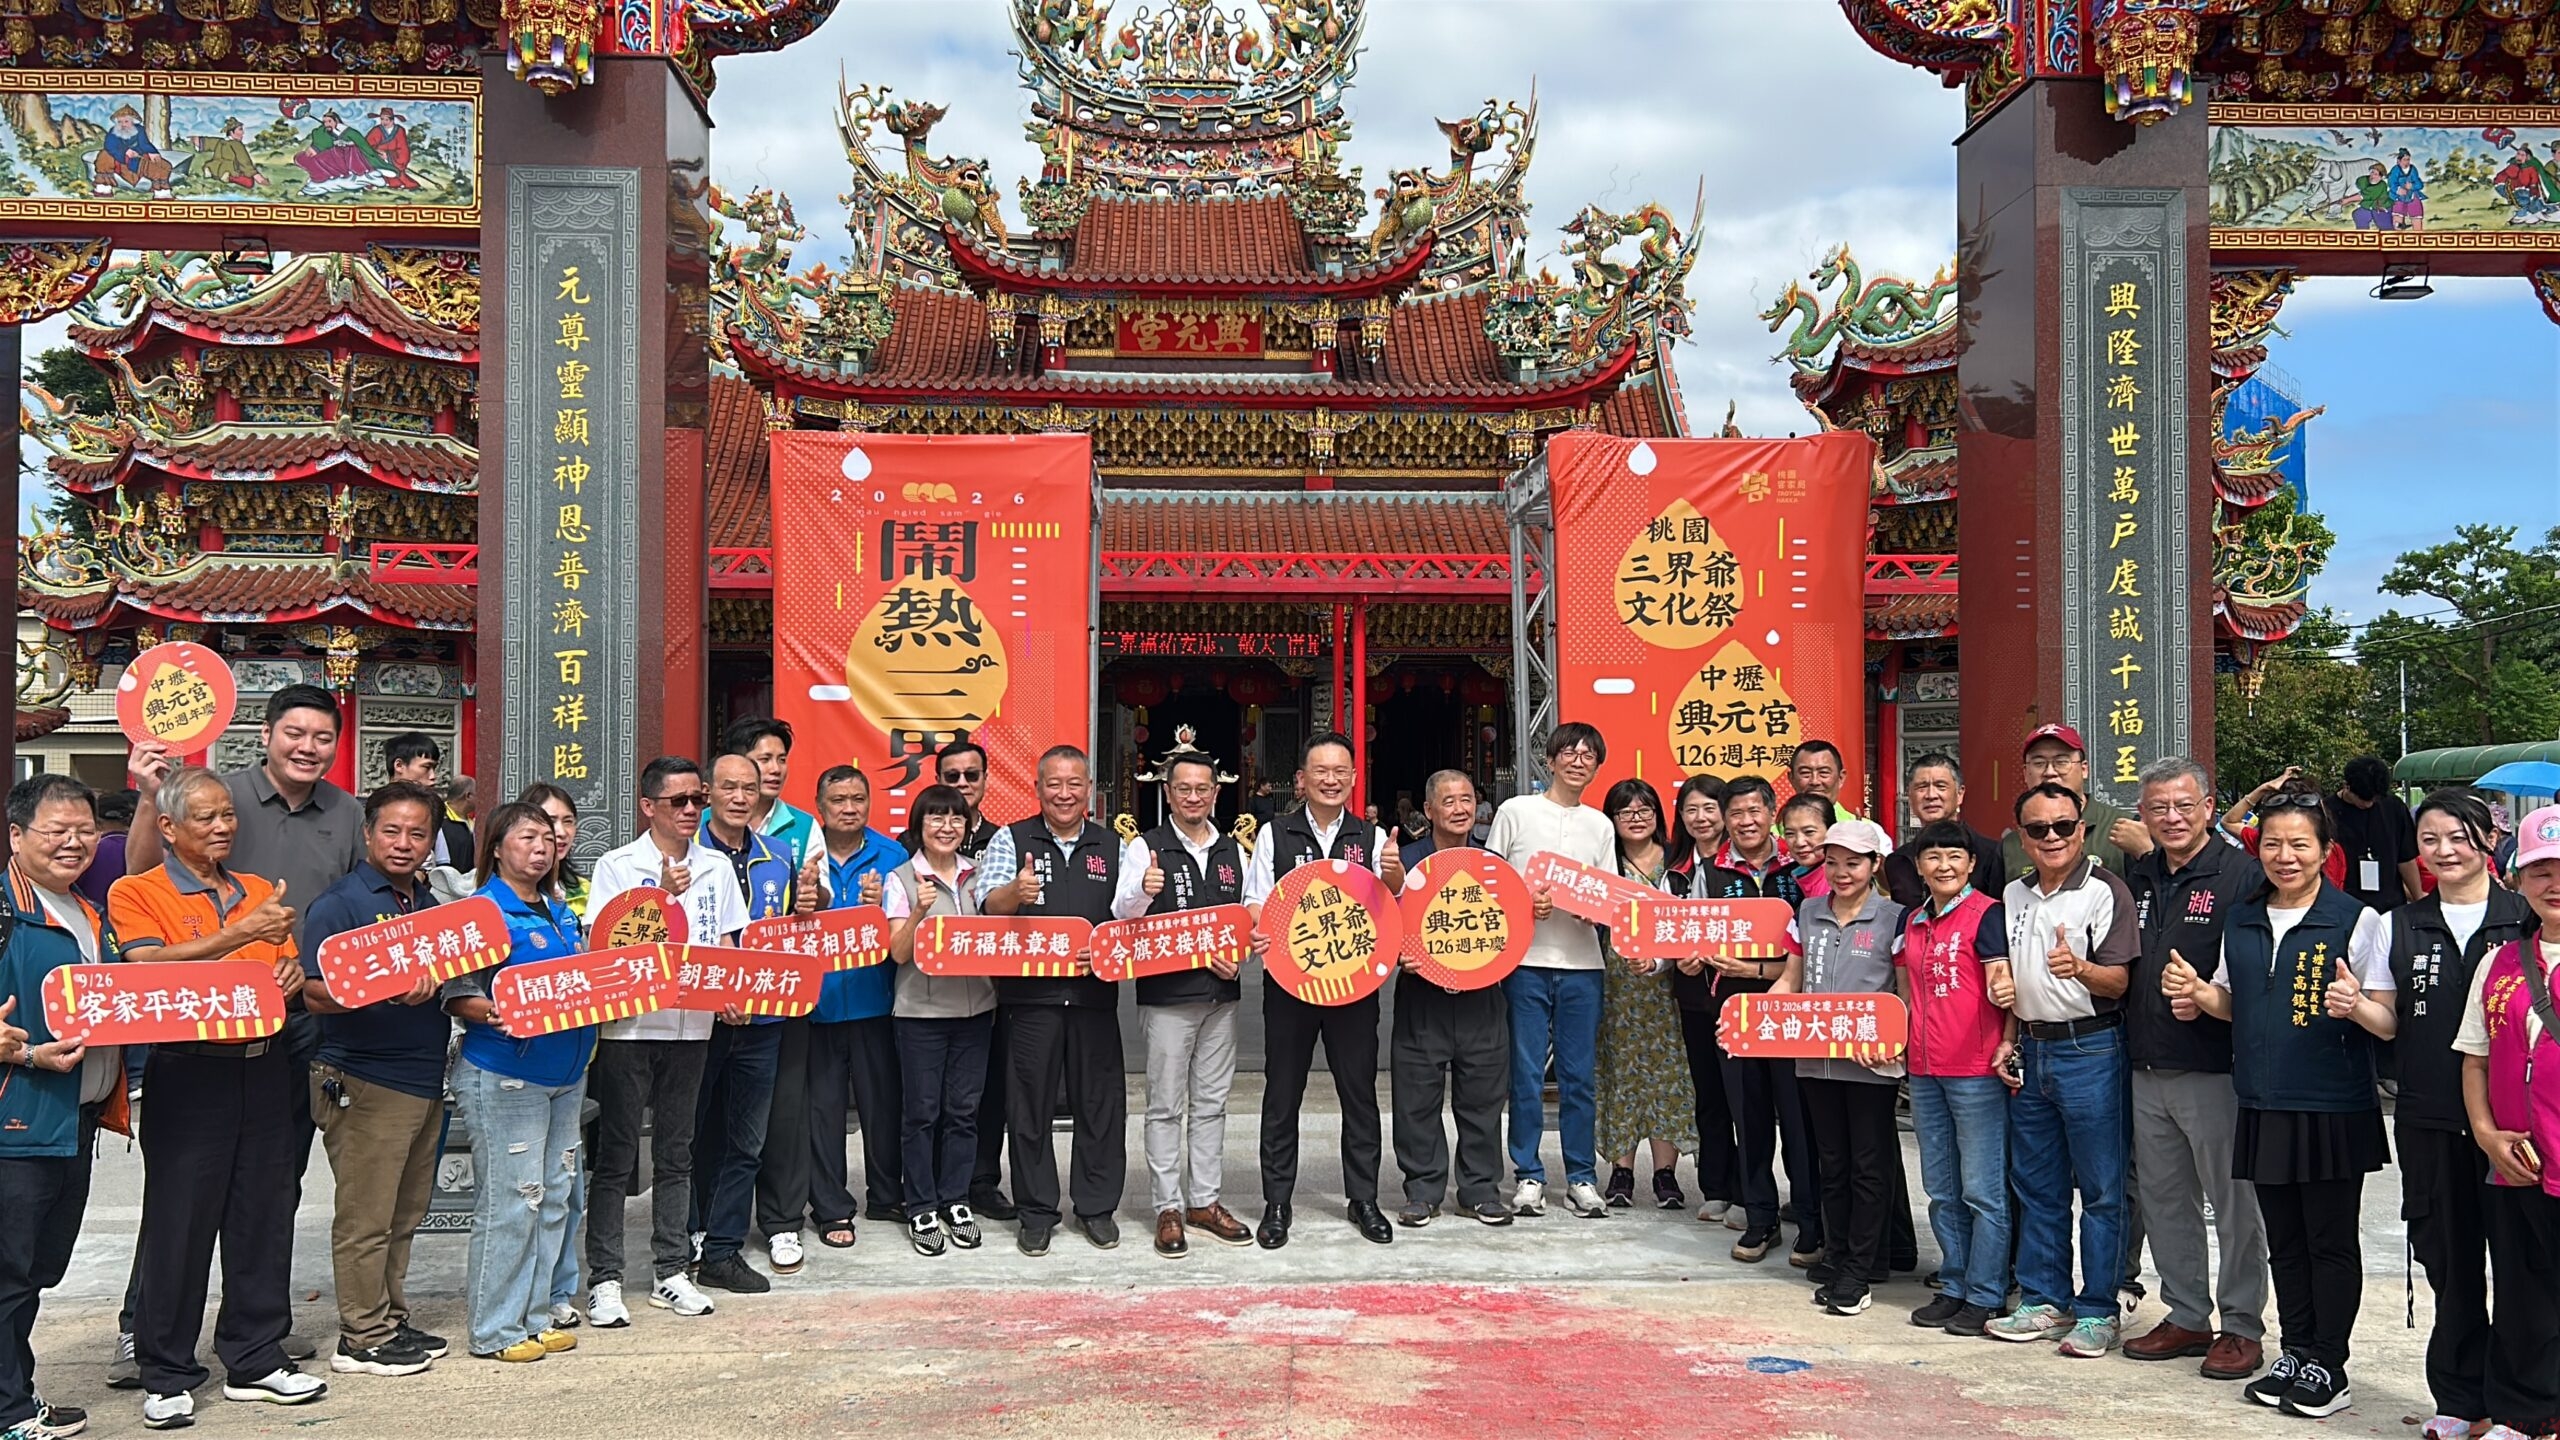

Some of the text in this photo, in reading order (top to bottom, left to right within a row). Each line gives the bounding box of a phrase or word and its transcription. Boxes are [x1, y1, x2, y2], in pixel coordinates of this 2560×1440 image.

[553, 266, 591, 780] 元尊靈顯神恩普濟百祥臨
[1645, 516, 1710, 545] 桃園
[2104, 281, 2143, 783] 興隆濟世萬戶虔誠千福至
[1621, 550, 1741, 588] 三界爺
[1620, 592, 1743, 628] 文化祭
[150, 669, 187, 693] 中壢
[1701, 665, 1765, 692] 中壢
[146, 682, 208, 721] 興元宮
[151, 701, 216, 736] 126週年慶
[1675, 700, 1797, 736] 興元宮
[1676, 743, 1797, 768] 126週年慶
[1173, 872, 1188, 911] 范姜泰
[1298, 885, 1341, 914] 桃園
[1440, 884, 1483, 905] 中壢
[632, 905, 662, 923] 桃園
[1292, 903, 1368, 945] 三界爺
[1425, 907, 1505, 934] 興元宮
[1653, 918, 1753, 943] 鼓海朝聖
[351, 921, 414, 950] 9/16-10/17
[364, 920, 488, 981] 三界爺特展
[949, 930, 1071, 957] 祈福集章趣
[1109, 924, 1238, 965] 令旗交接儀式
[1299, 929, 1378, 973] 文化祭
[1426, 935, 1507, 955] 126週年慶
[79, 972, 114, 988] 9/26
[517, 955, 660, 1005] 鬧熱三界
[678, 961, 801, 996] 朝聖小旅行
[2428, 943, 2442, 986] 平鎮區長
[555, 996, 591, 1010] ngied
[2412, 954, 2429, 1017] 蕭巧如
[77, 985, 261, 1027] 客家平安大戲
[1755, 1012, 1878, 1042] 金曲大歌廳
